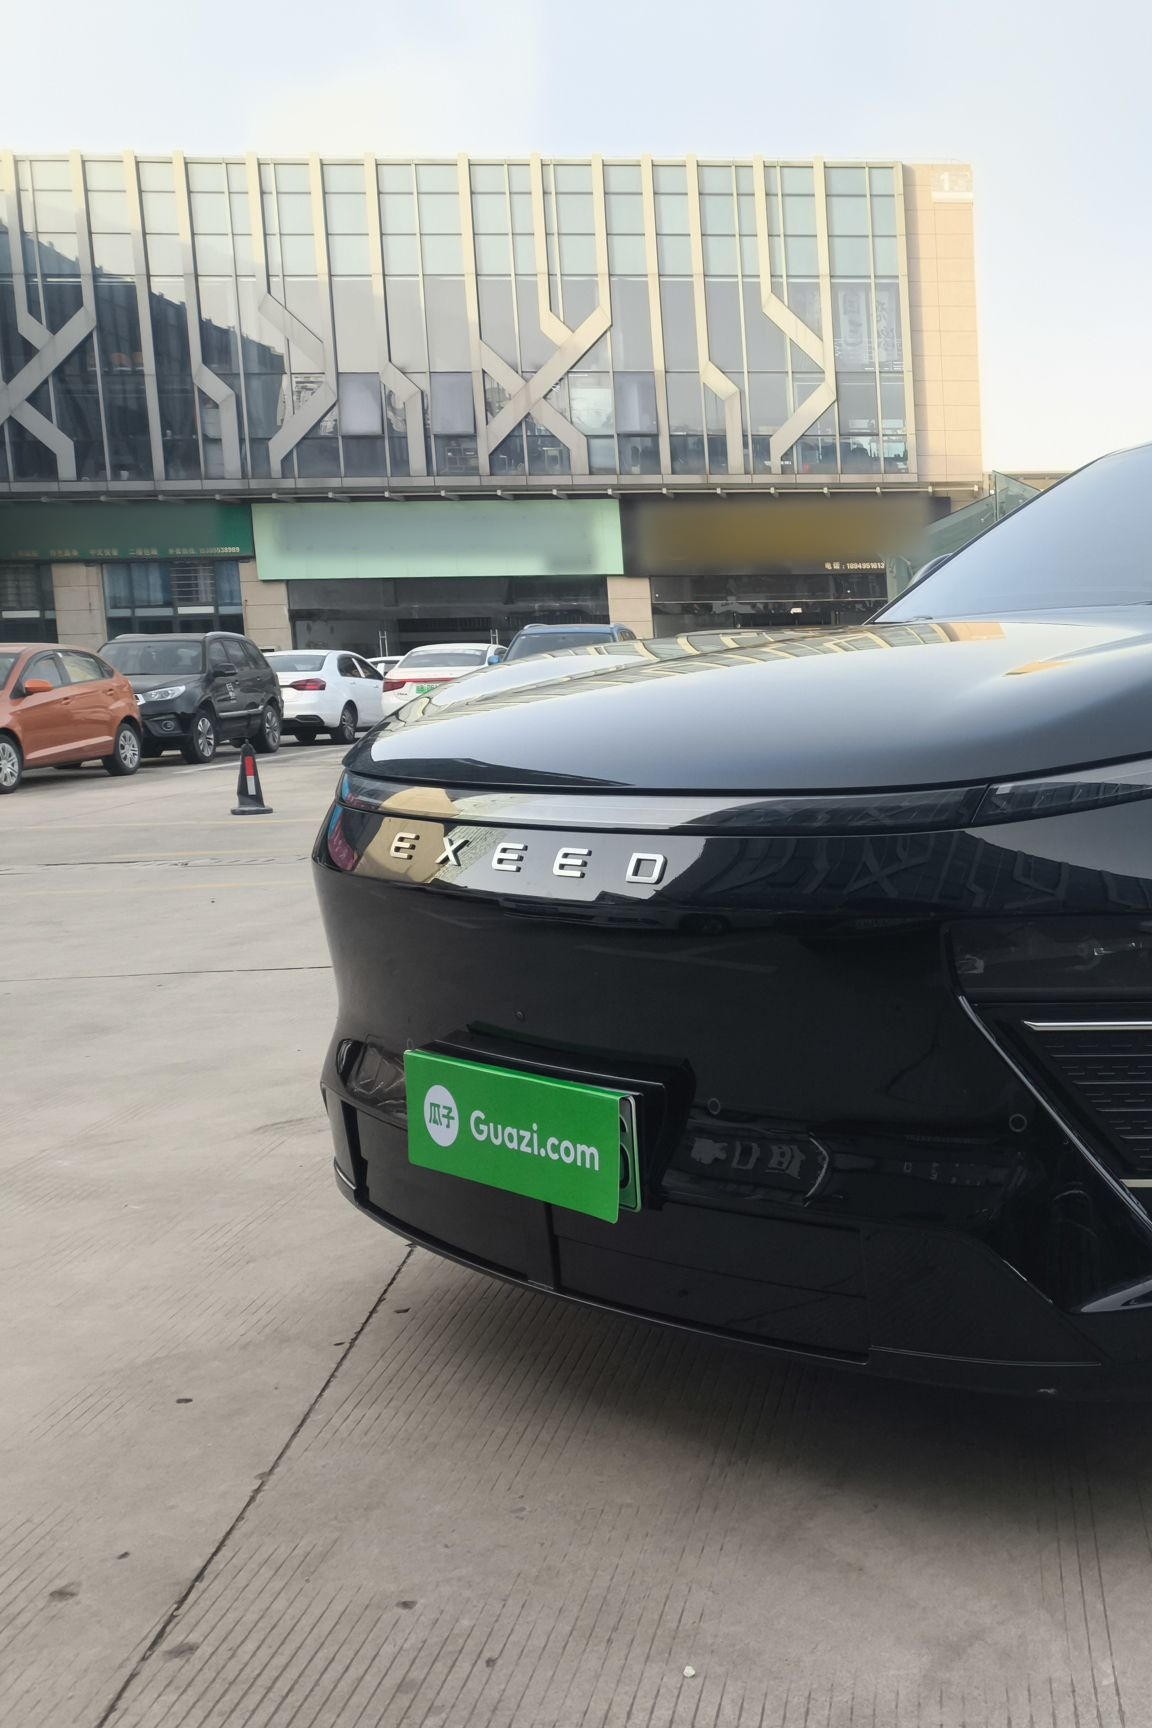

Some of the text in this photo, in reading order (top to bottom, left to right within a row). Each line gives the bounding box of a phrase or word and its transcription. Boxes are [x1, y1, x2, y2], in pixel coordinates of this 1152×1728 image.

[389, 831, 667, 885] EXEED
[428, 1101, 456, 1129] 瓜子
[469, 1109, 600, 1172] Guazi.com
